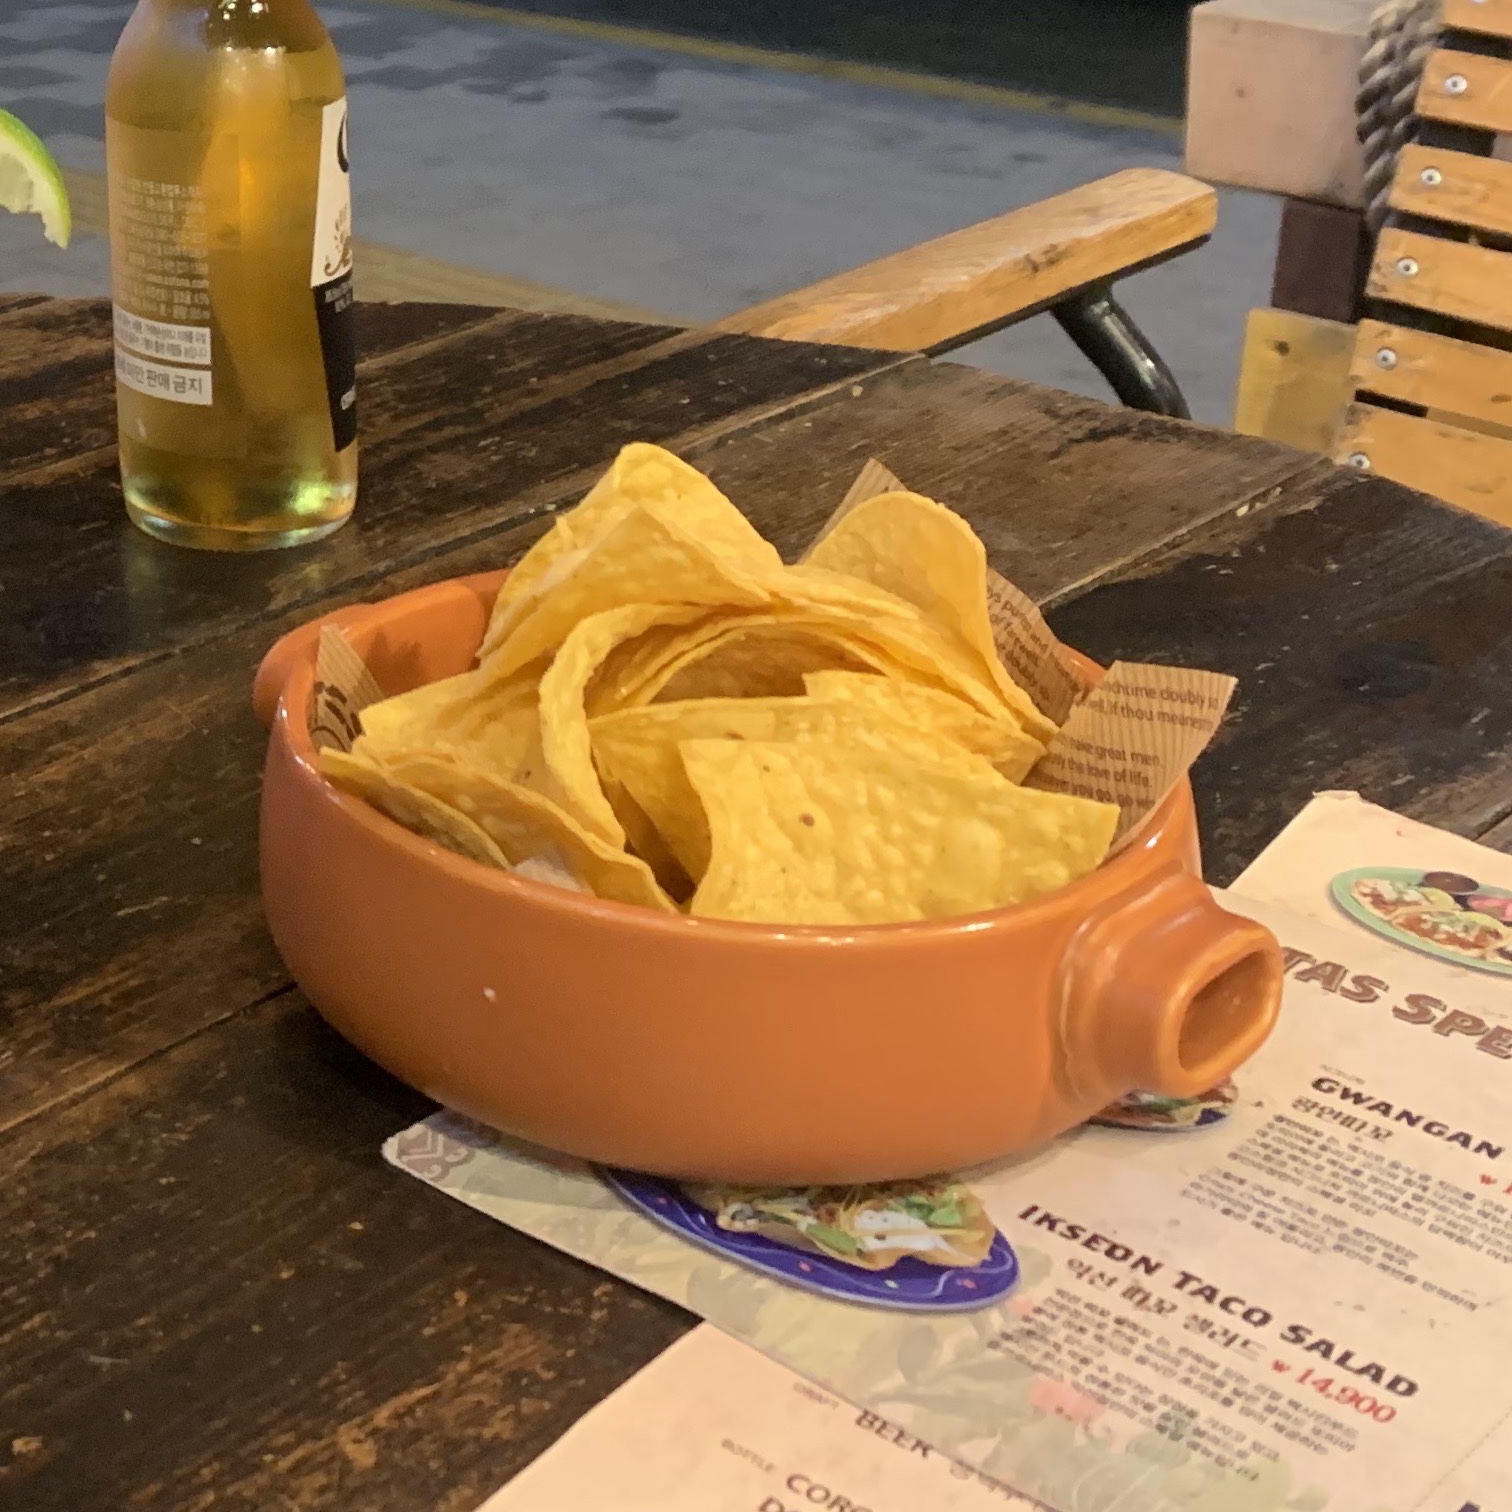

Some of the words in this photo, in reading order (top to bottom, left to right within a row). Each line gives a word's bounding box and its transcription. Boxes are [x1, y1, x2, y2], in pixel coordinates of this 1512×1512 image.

[146, 369, 171, 391] 판매
[173, 374, 203, 396] 금지
[1120, 703, 1155, 721] thou
[1160, 689, 1206, 711] doubly
[1094, 746, 1127, 762] great
[1130, 751, 1160, 766] men
[1113, 768, 1127, 783] of
[1282, 946, 1389, 1005] TAS
[1392, 992, 1512, 1060] SPE
[1310, 1076, 1506, 1159] GWANGAN
[1017, 1204, 1165, 1276] IKSEON
[1172, 1270, 1273, 1329] TACO
[1279, 1324, 1420, 1397] SALAD
[786, 1473, 873, 1512] COR
